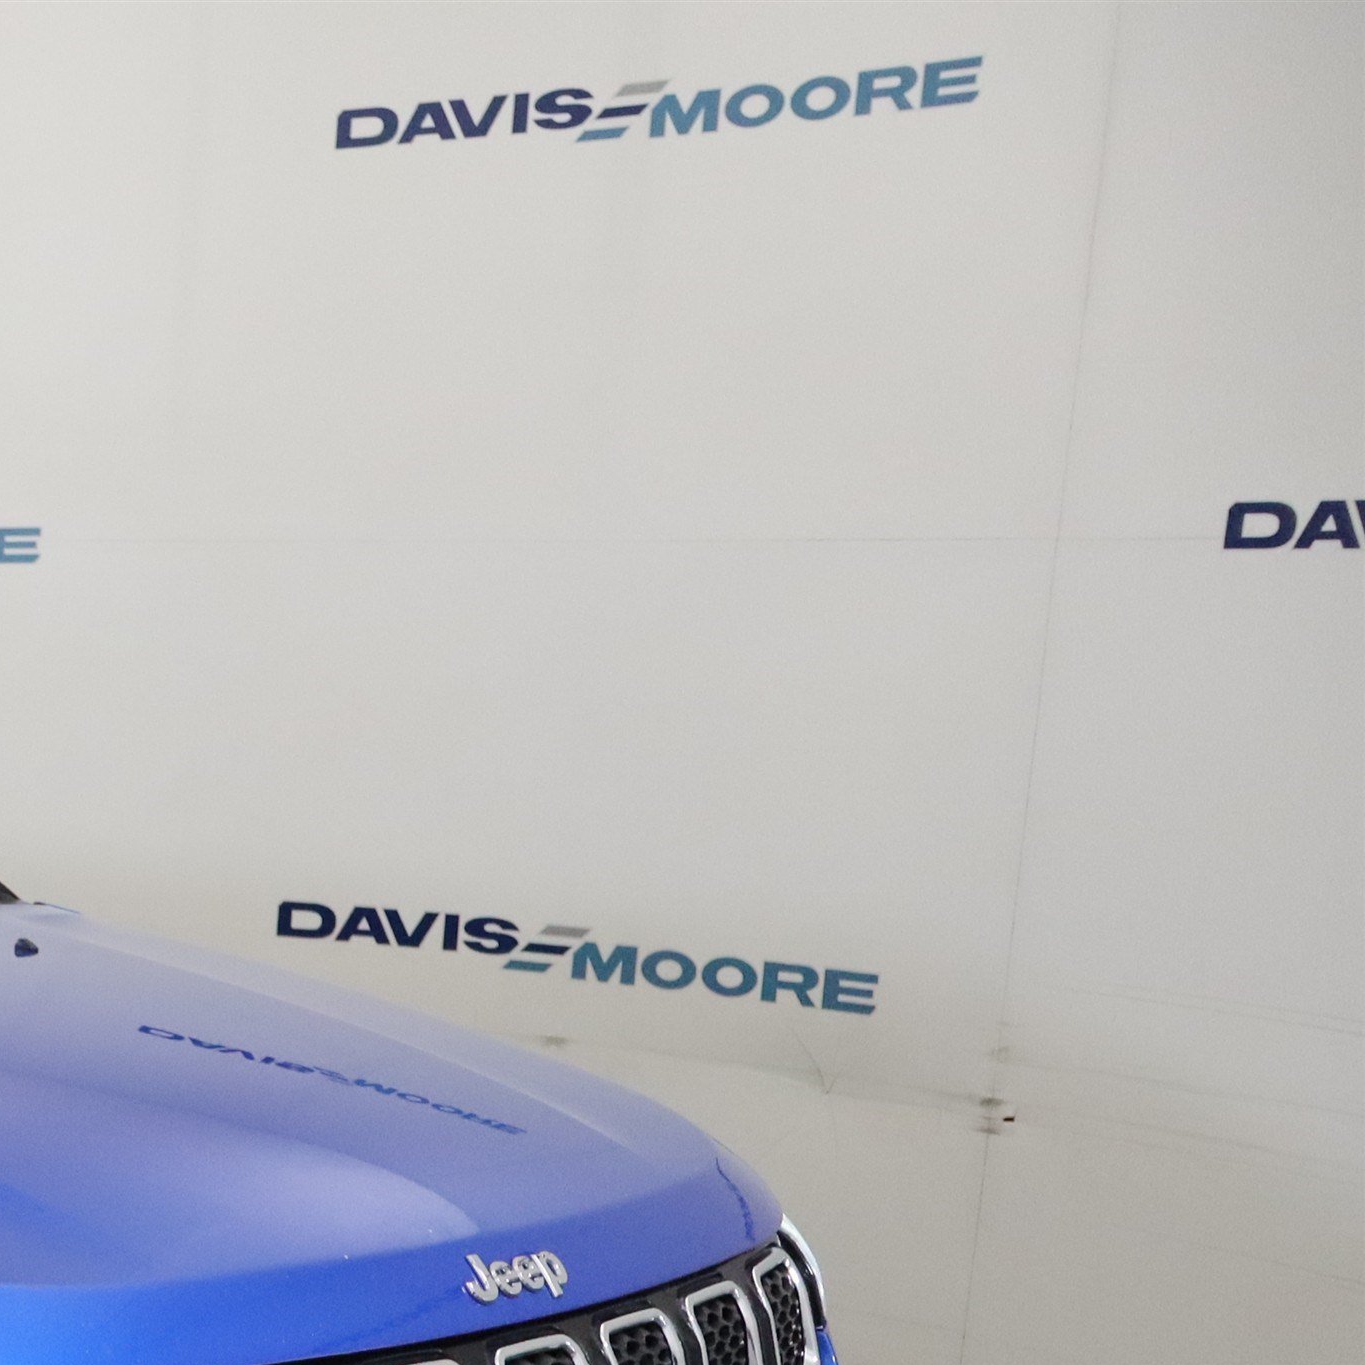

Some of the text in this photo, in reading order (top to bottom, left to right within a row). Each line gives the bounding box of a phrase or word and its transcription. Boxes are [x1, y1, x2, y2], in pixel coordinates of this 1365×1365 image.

[335, 55, 984, 150] DAVIS MOORE
[1222, 499, 1365, 550] DA
[275, 900, 880, 1016] DAVIS MOORE
[463, 1250, 569, 1306] Jeep
